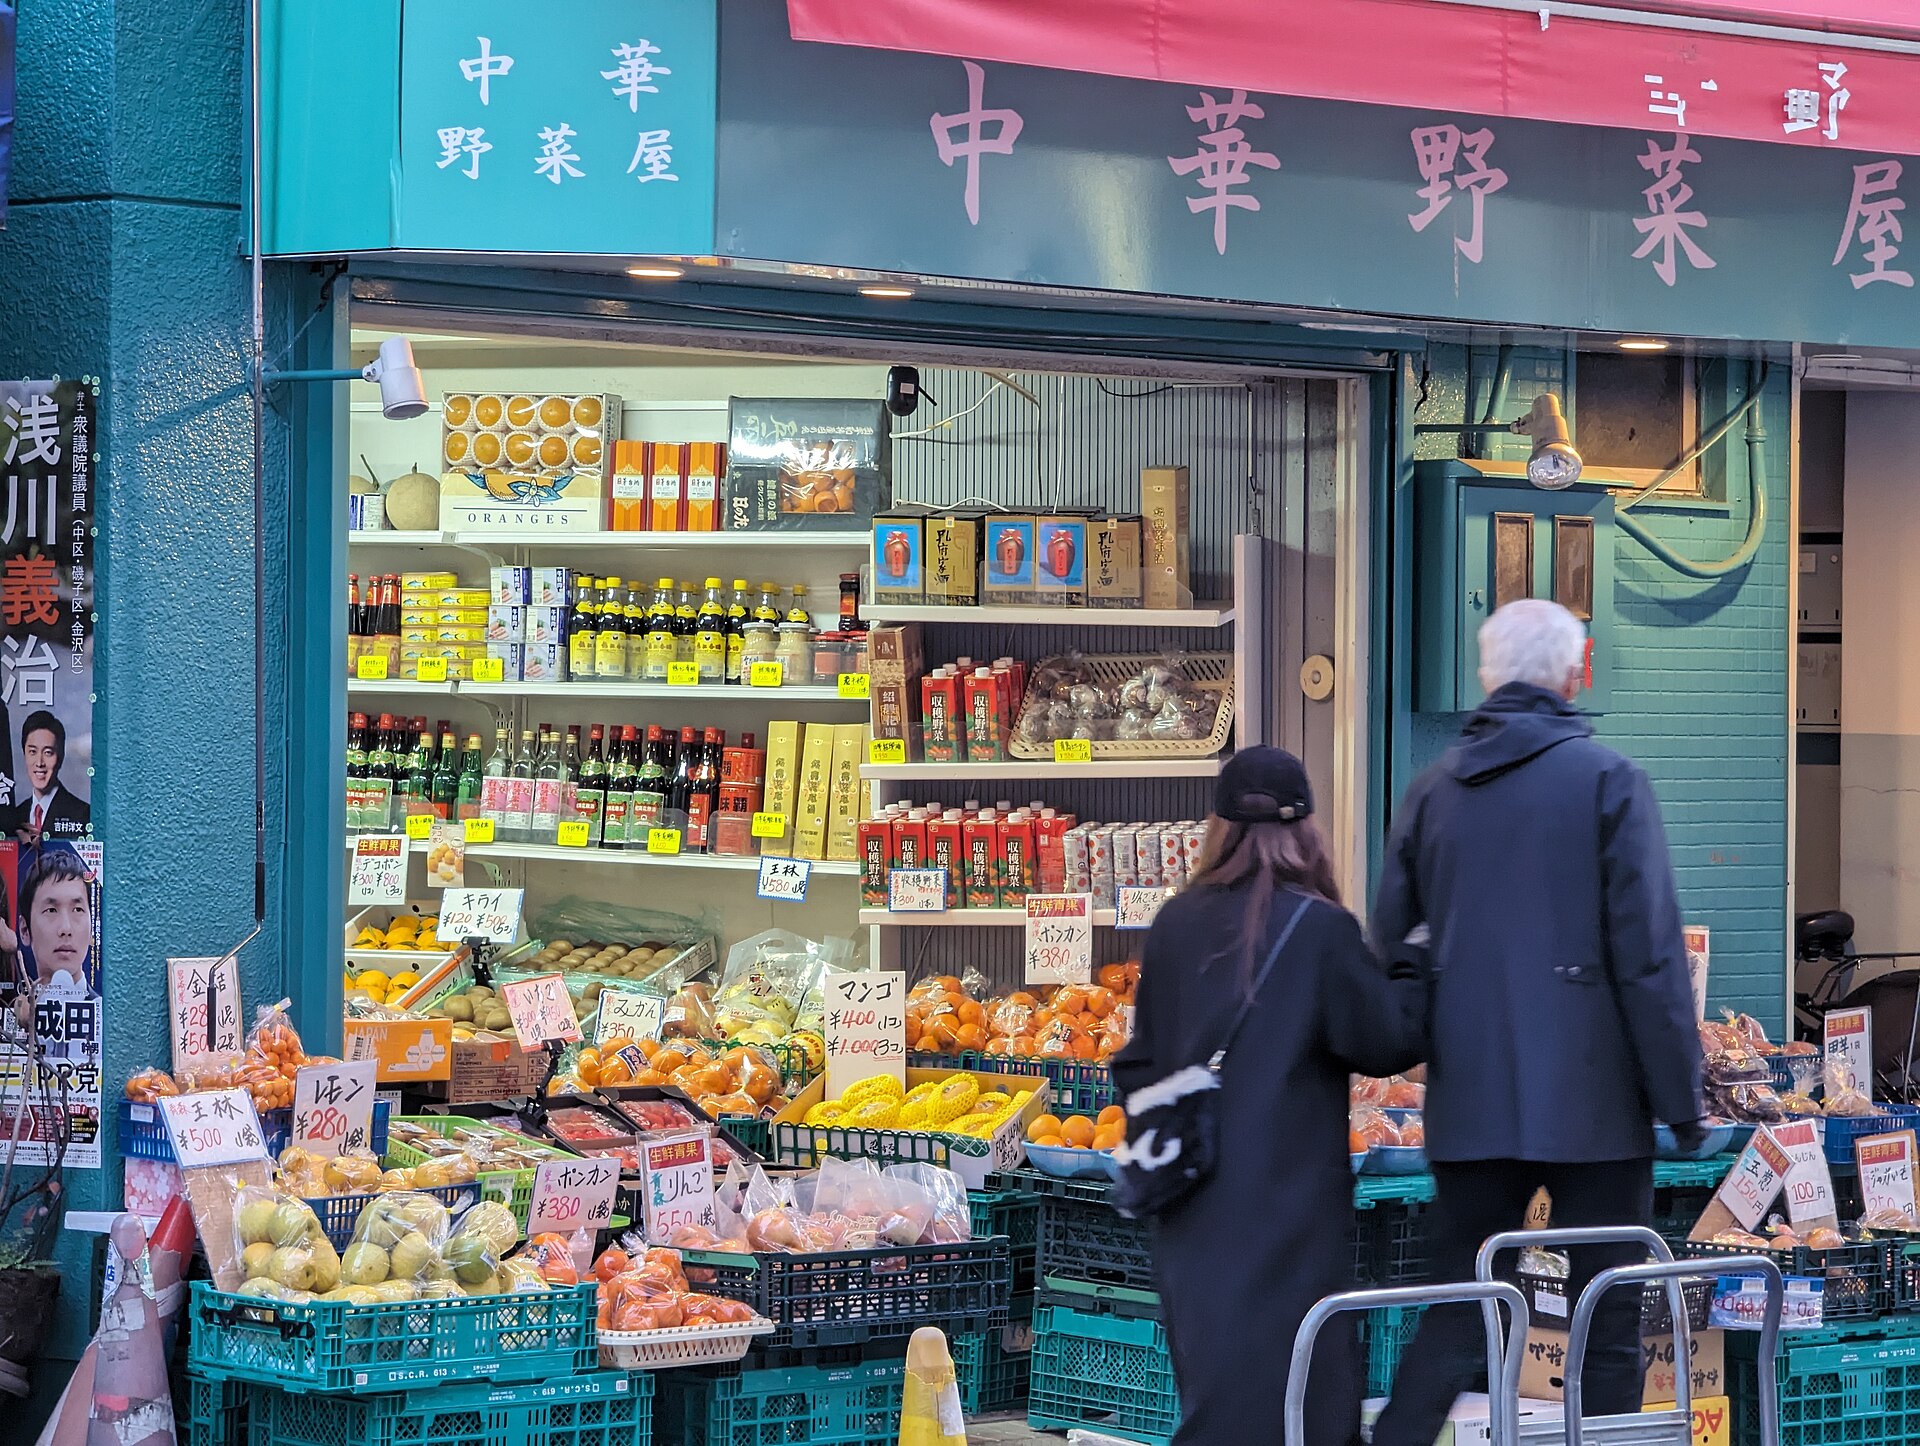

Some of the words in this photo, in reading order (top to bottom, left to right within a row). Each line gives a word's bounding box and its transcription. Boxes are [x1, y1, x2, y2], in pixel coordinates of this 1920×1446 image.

[459, 37, 672, 113] 中華
[436, 122, 680, 185] 野菜屋
[930, 60, 1915, 290] 中華野菜屋
[468, 513, 569, 525] ORANGES
[1, 395, 62, 707] 浅川義治
[931, 695, 943, 742] 収穫野菜
[974, 695, 986, 742] 収穫野菜
[54, 822, 83, 833] 吉村洋文
[358, 839, 400, 852] 生鮮青果
[362, 858, 404, 872] デコポン
[769, 863, 801, 878] 王林
[867, 840, 880, 887] 収穫野菜
[972, 841, 985, 888] 収穫野菜
[1007, 842, 1020, 888] 収穫野菜
[352, 873, 374, 886] ¥300
[376, 872, 400, 887] ¥800
[761, 875, 790, 893] ¥580
[443, 912, 472, 928] ¥120
[477, 913, 507, 929] ¥500
[1037, 925, 1087, 944] ポンカン
[1028, 947, 1071, 970] ¥380
[523, 980, 558, 1005] いちご
[838, 977, 898, 1003] マンゴ
[35, 1000, 95, 1041] 成田
[614, 999, 656, 1018] みかん
[829, 1009, 876, 1031] ¥400
[601, 1022, 635, 1040] ¥350
[315, 1075, 364, 1105] レモン
[191, 1094, 244, 1123] 王林
[296, 1106, 348, 1142] ¥280
[177, 1128, 222, 1152] ¥500
[1862, 1143, 1900, 1160] 生鮮青果
[650, 1142, 699, 1164] 生鮮青果
[557, 1163, 613, 1190] ポンカン
[668, 1166, 708, 1203] りんご
[1791, 1181, 1814, 1201] 100
[1817, 1185, 1826, 1199] 円
[537, 1195, 580, 1221] ¥380
[398, 1371, 429, 1380] S.C.R.
[433, 1368, 448, 1377] 613
